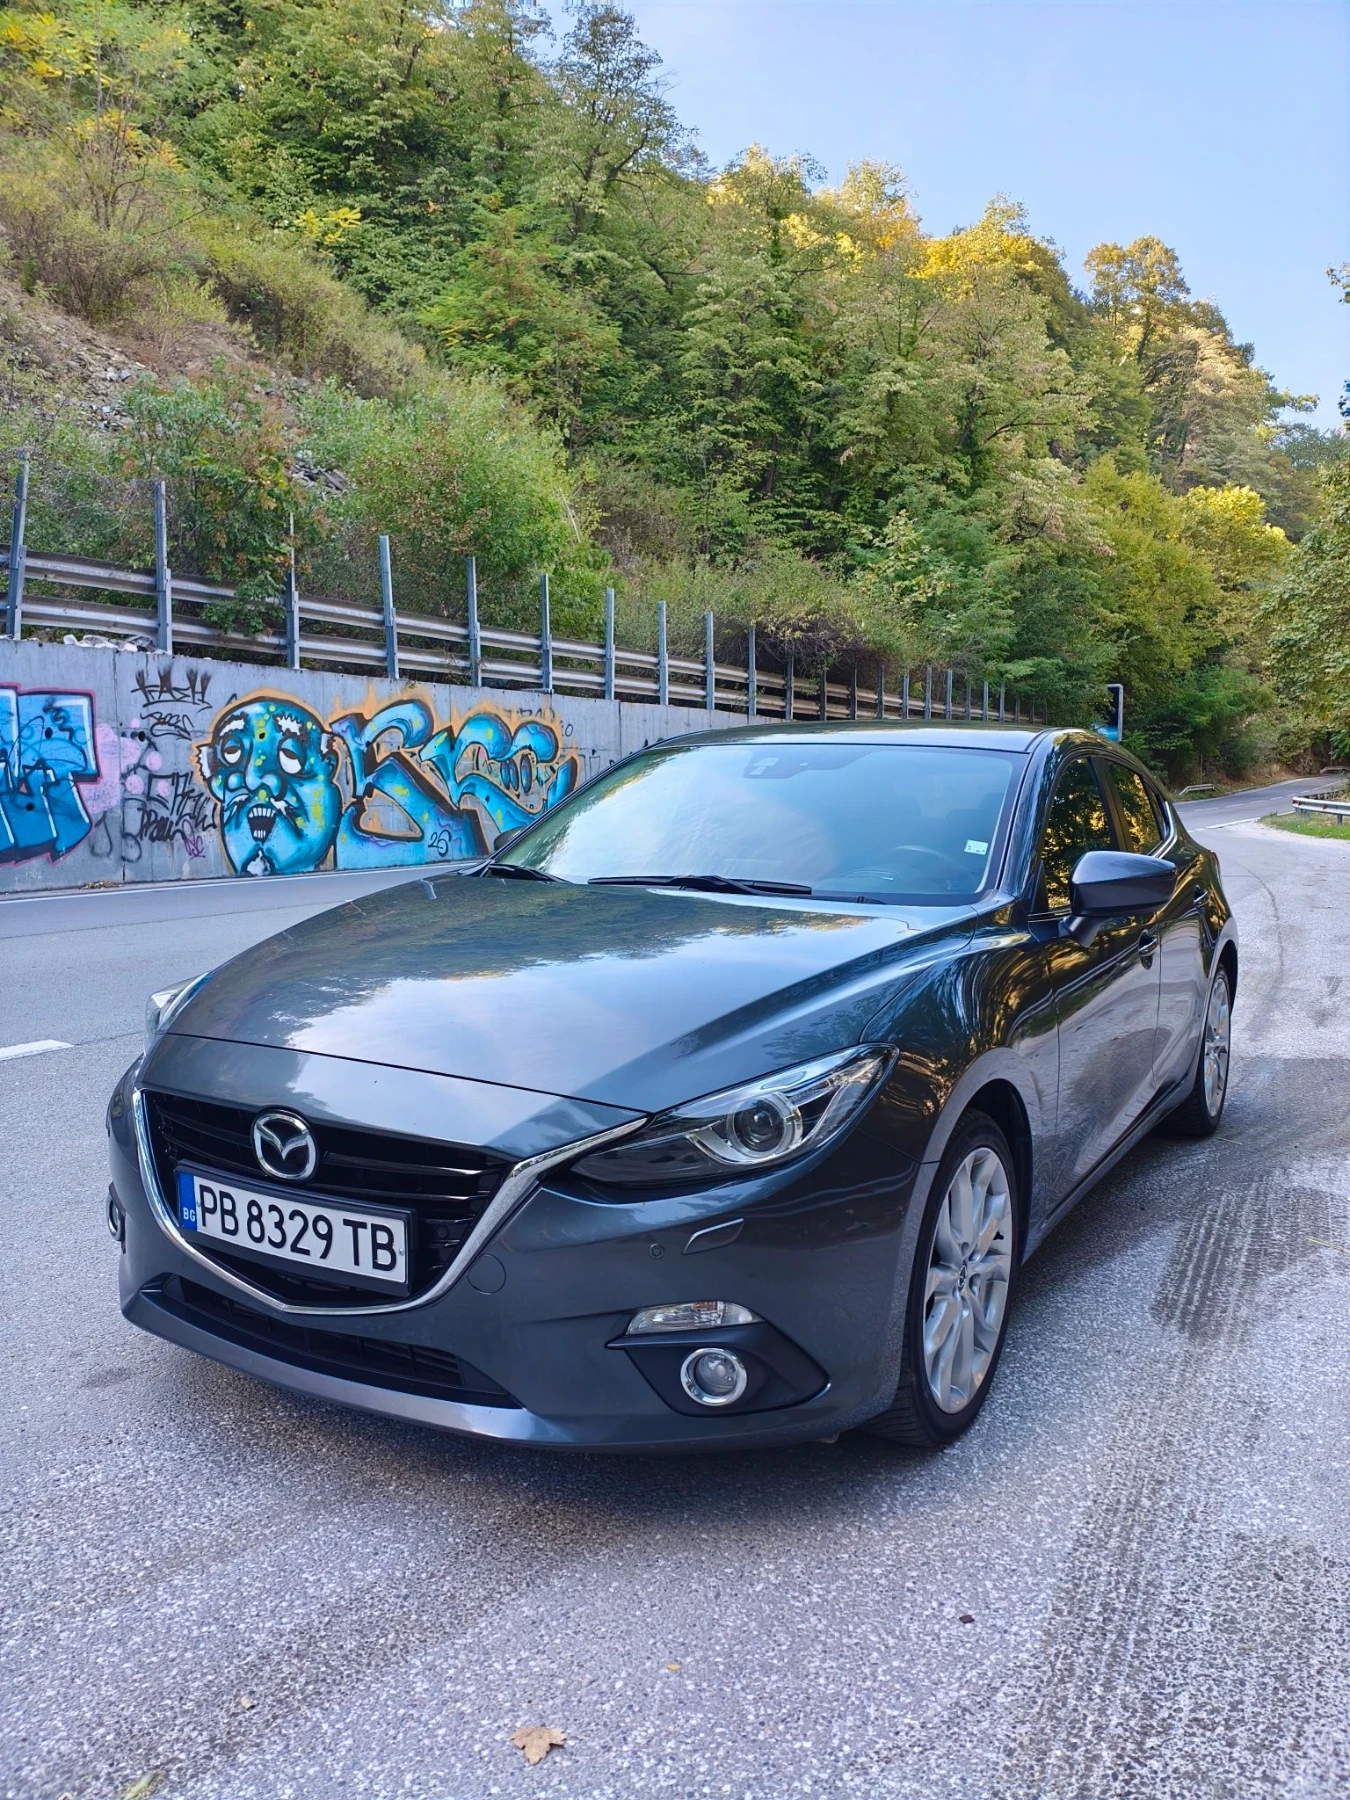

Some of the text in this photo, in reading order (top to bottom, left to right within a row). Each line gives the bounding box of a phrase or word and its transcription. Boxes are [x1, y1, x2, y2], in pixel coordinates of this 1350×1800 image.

[182, 1206, 196, 1222] BG
[199, 1184, 397, 1272] PB 8329 TB
